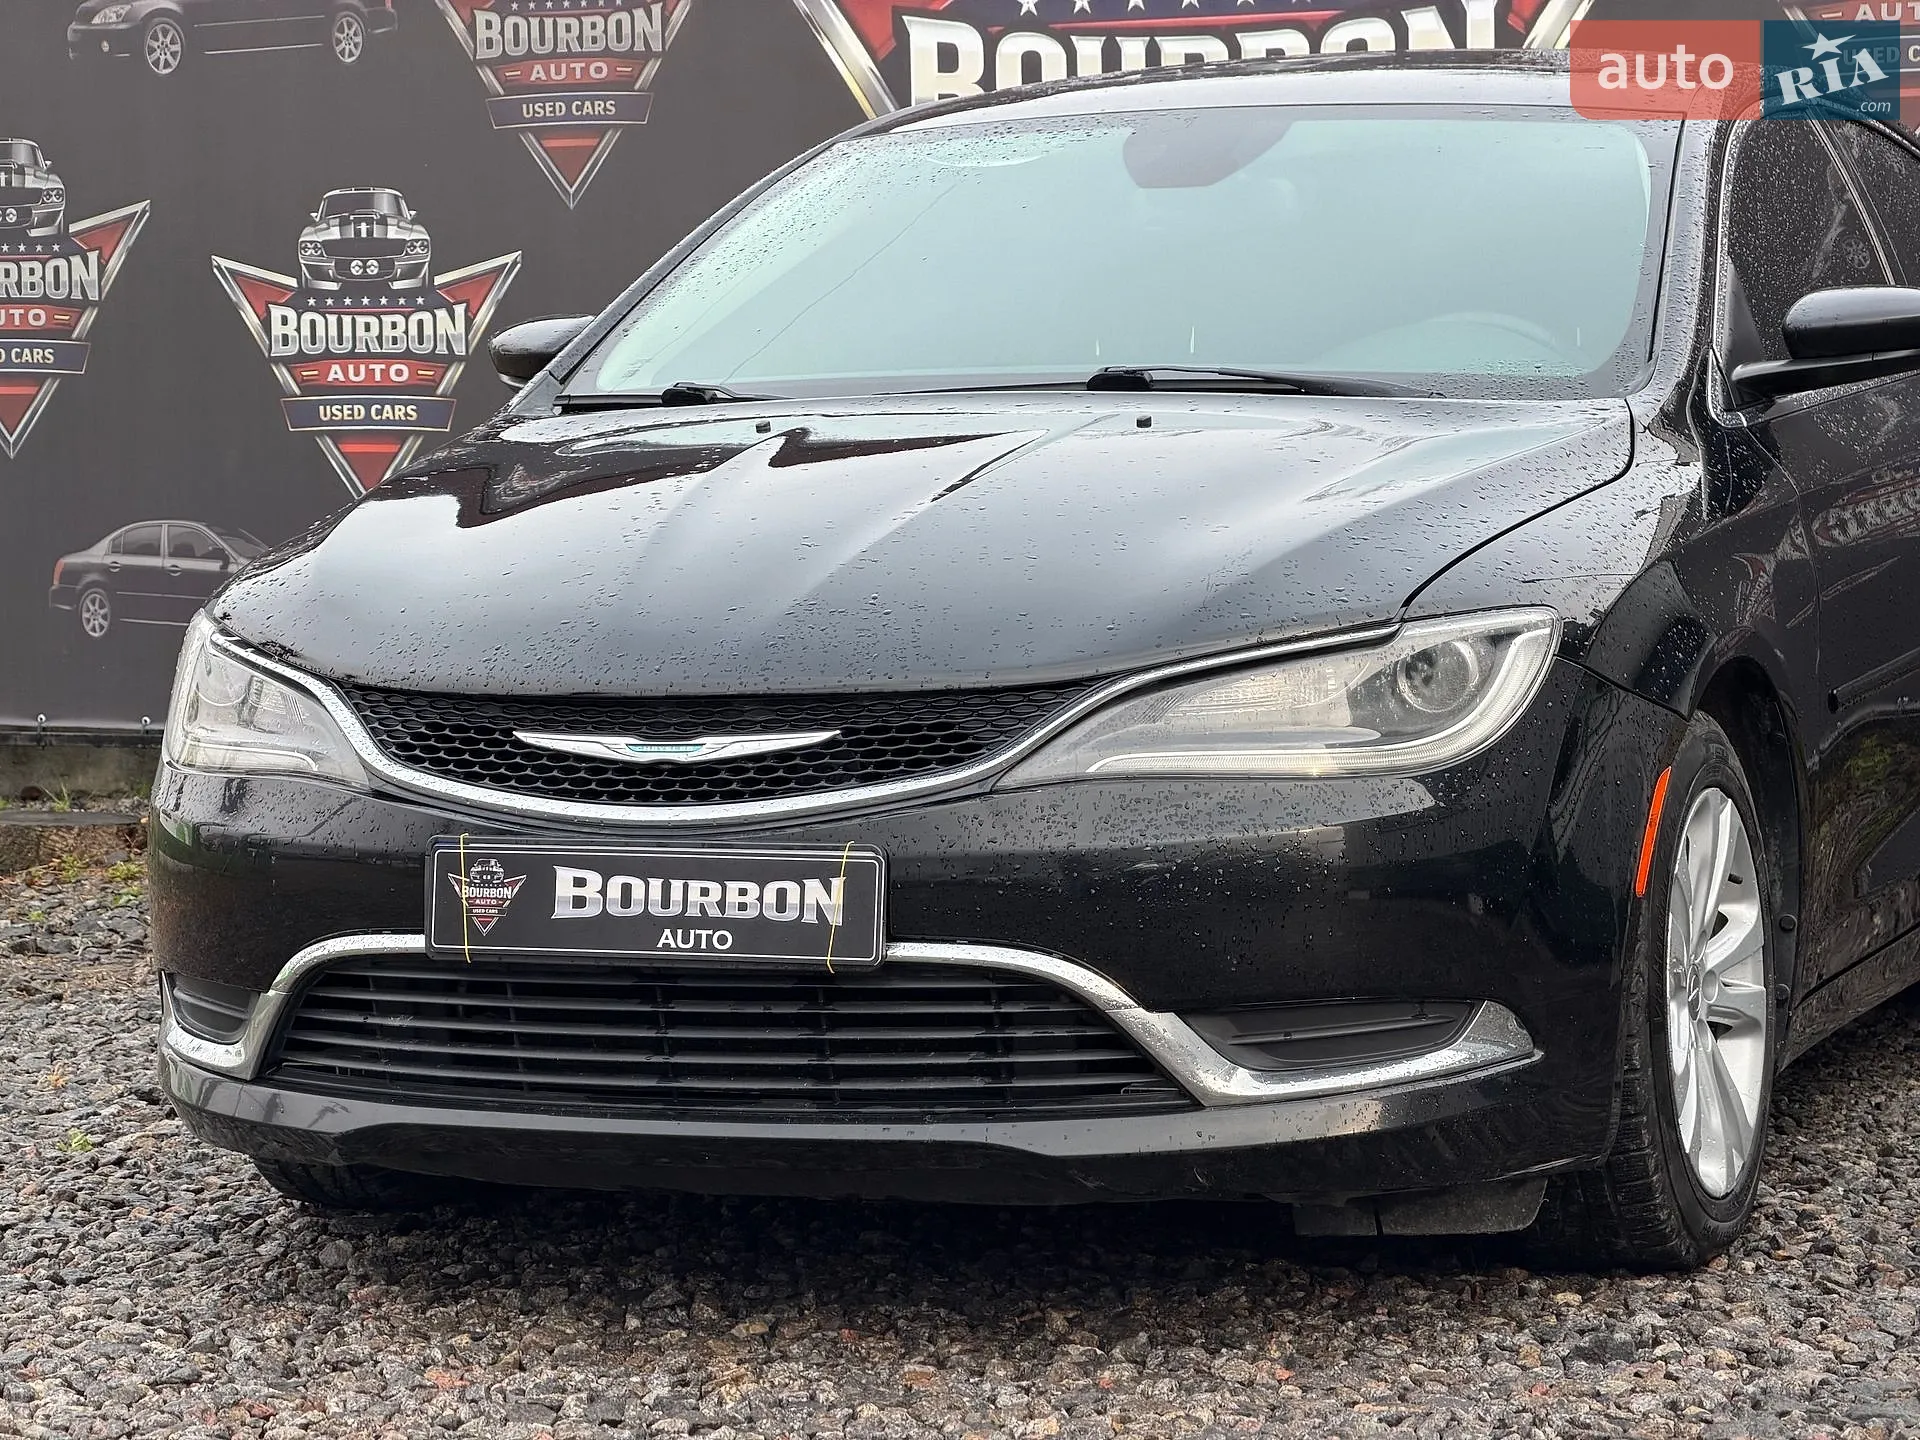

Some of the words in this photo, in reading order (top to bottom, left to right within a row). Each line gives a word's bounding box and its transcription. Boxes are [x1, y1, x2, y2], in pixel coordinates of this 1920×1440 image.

[1854, 1, 1920, 22] AUT
[473, 2, 663, 59] BOURBON
[1843, 46, 1900, 66] UED
[529, 62, 609, 81] AUTO
[522, 102, 566, 118] USED
[571, 100, 616, 116] CARS
[0, 250, 100, 301] RBON
[268, 303, 467, 357] BOURBON
[11, 347, 55, 364] CARS
[327, 364, 410, 382] AUTO
[319, 404, 366, 421] USED
[370, 404, 418, 421] CARS
[551, 865, 847, 927] BOURBON
[656, 928, 733, 951] AUTO
